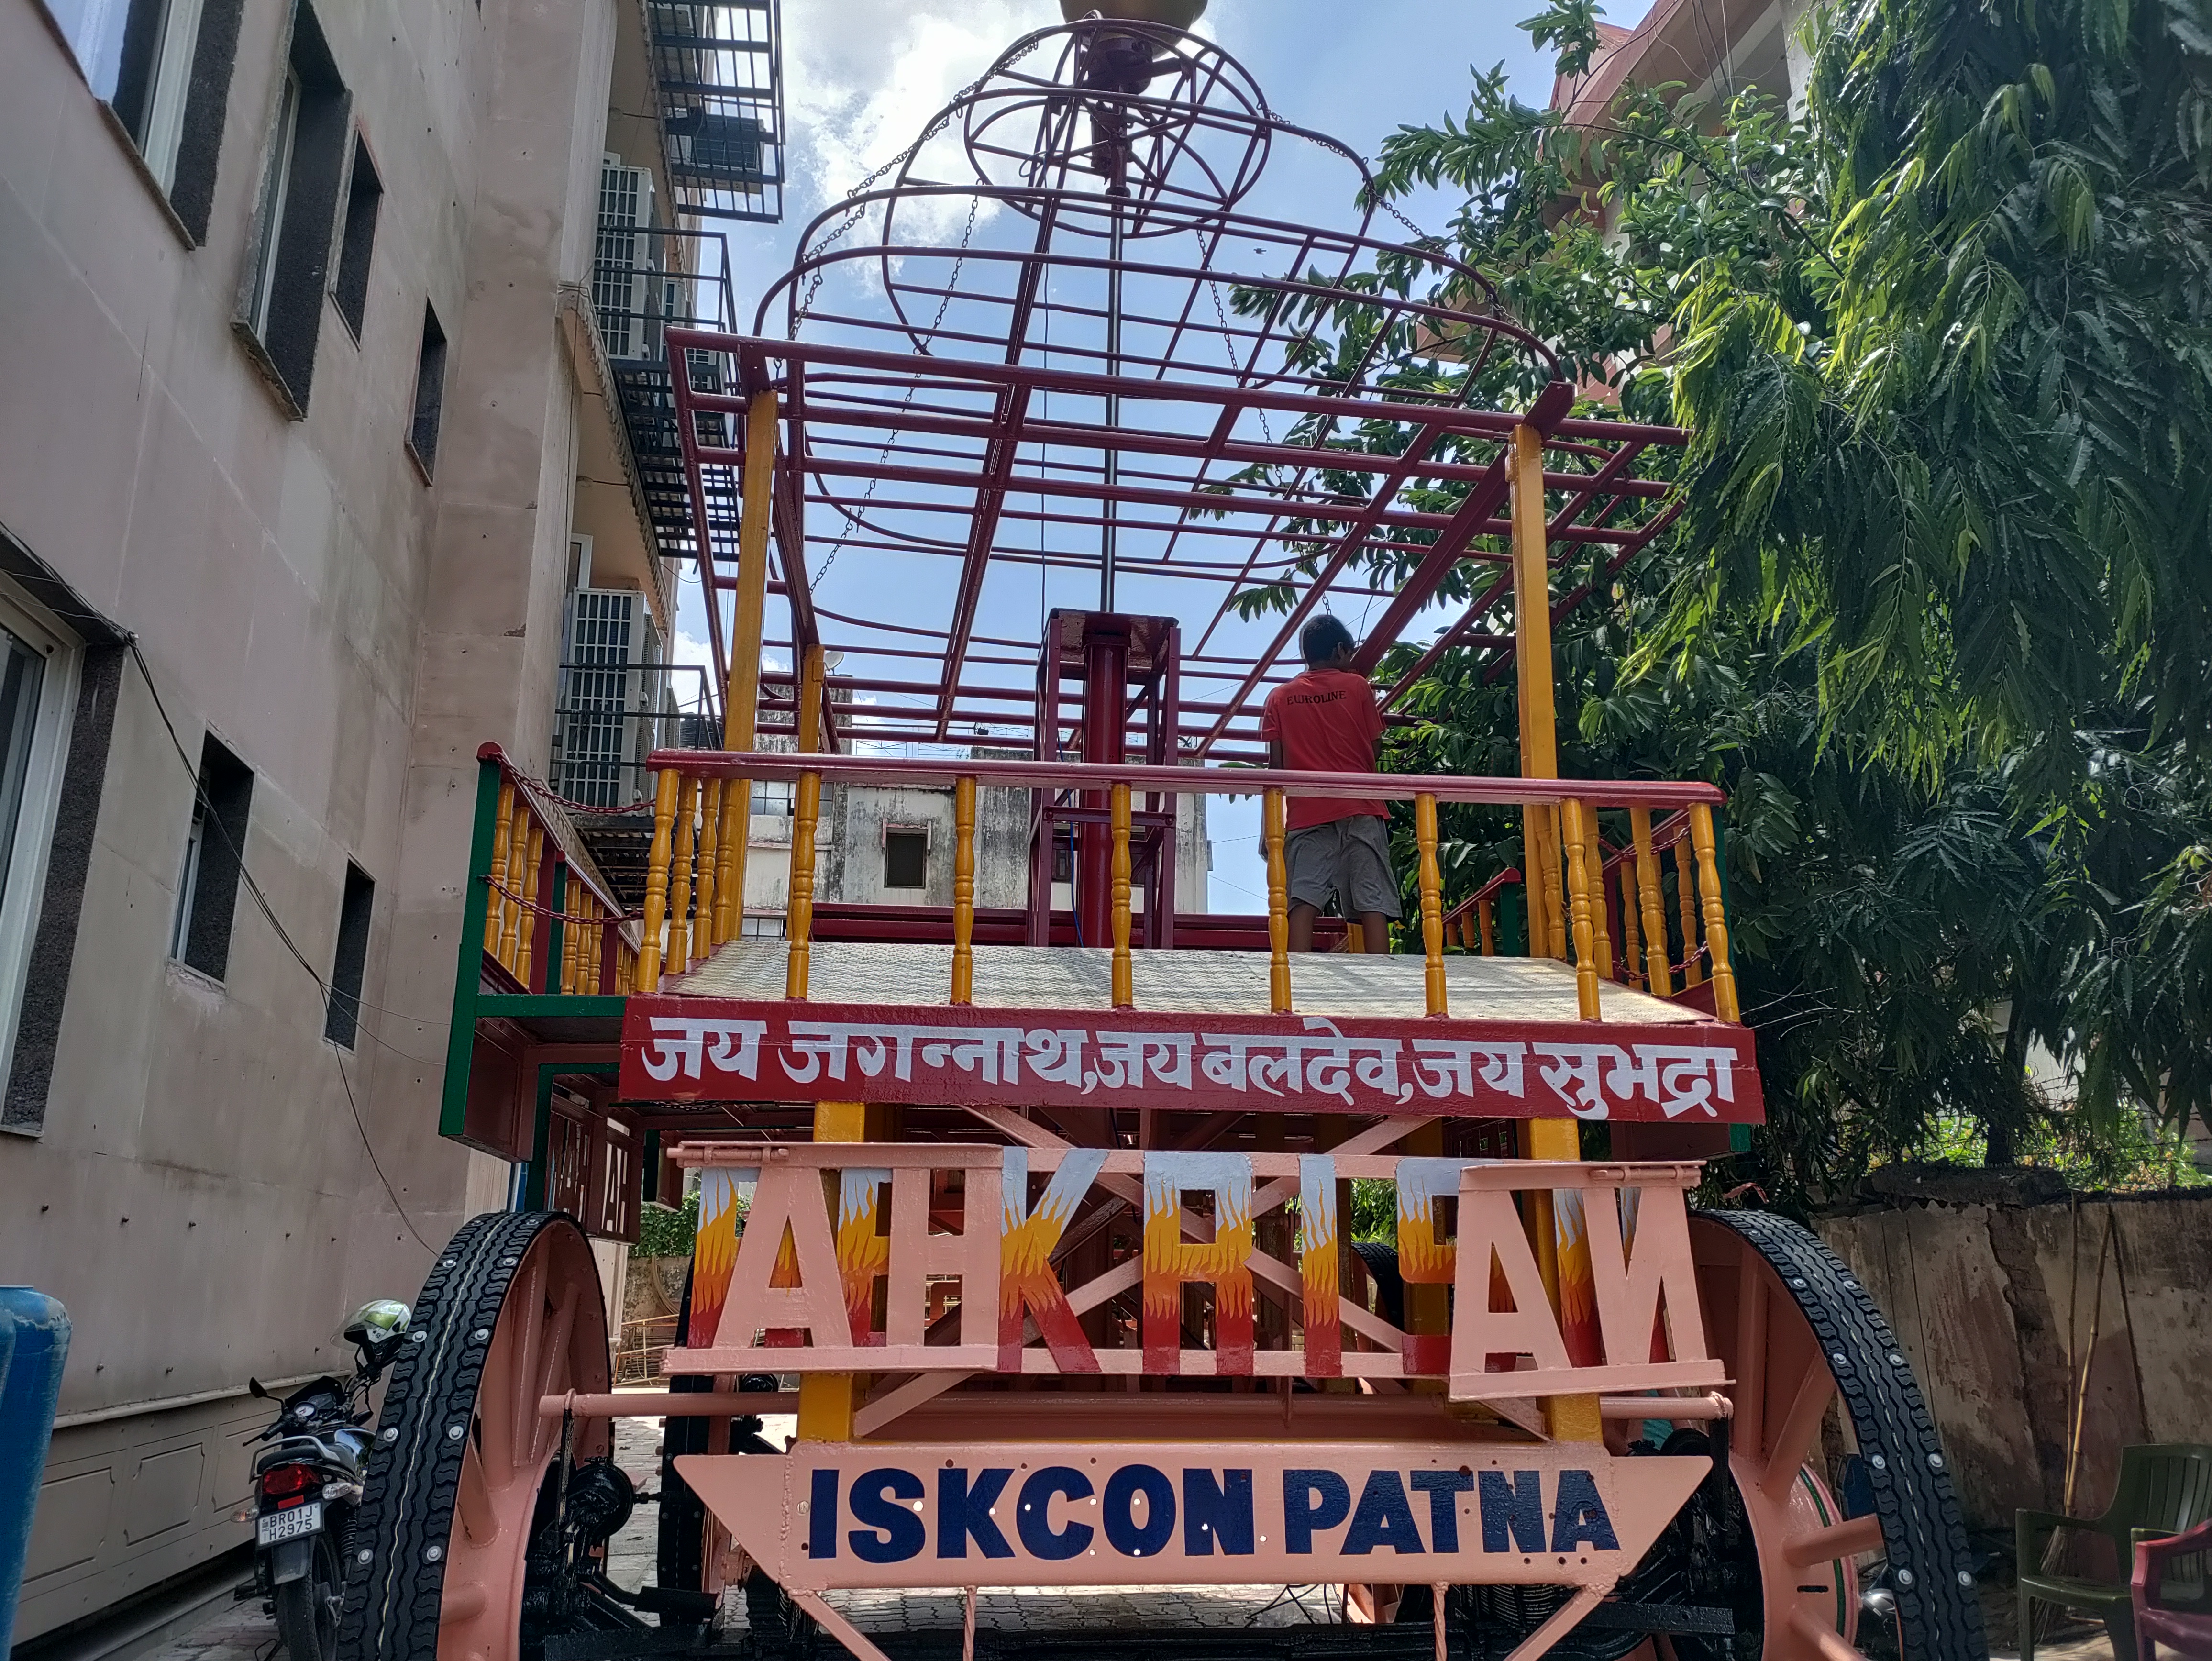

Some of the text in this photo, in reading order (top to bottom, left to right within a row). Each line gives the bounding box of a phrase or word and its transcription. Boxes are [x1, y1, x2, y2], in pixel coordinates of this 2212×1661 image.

[1287, 690, 1347, 705] EUROLINE
[641, 1017, 768, 1082] जय
[1532, 1042, 1738, 1120] सुभद्रा
[270, 1506, 312, 1528] BR01J
[809, 1464, 1620, 1563] ISKCON PATNA
[269, 1518, 312, 1540] H2975
